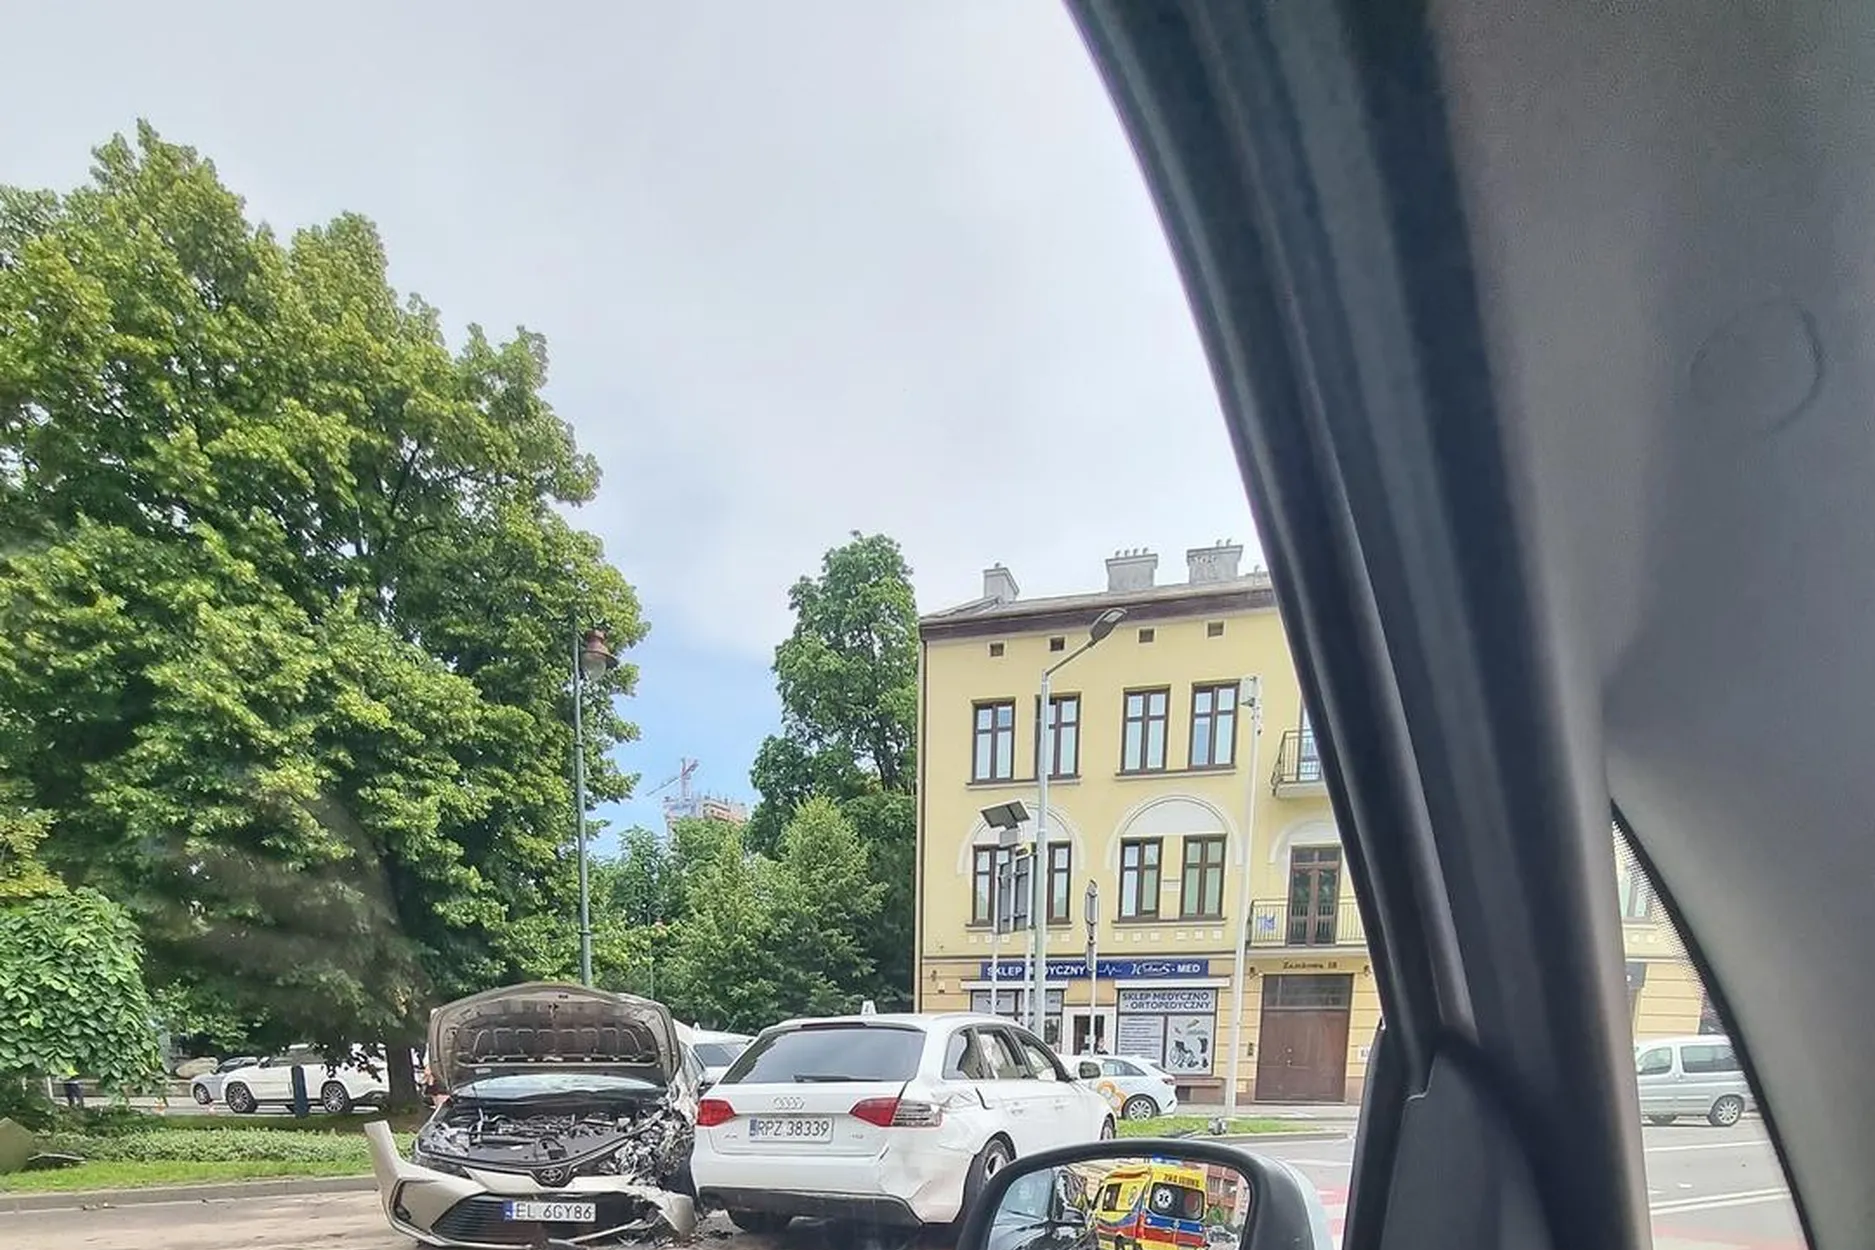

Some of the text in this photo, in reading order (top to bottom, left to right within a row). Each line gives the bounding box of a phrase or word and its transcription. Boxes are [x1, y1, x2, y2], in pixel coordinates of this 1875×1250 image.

[987, 966, 1023, 977] SKLEP
[1029, 965, 1086, 976] YCZNY
[1122, 992, 1209, 1000] SKLEP MEDYCZNO
[1130, 1001, 1211, 1009] ORTOPEDYCZNY
[758, 1120, 782, 1136] RPZ
[787, 1120, 829, 1137] 38339
[516, 1203, 535, 1218] EL
[543, 1204, 592, 1219] 6GY86
